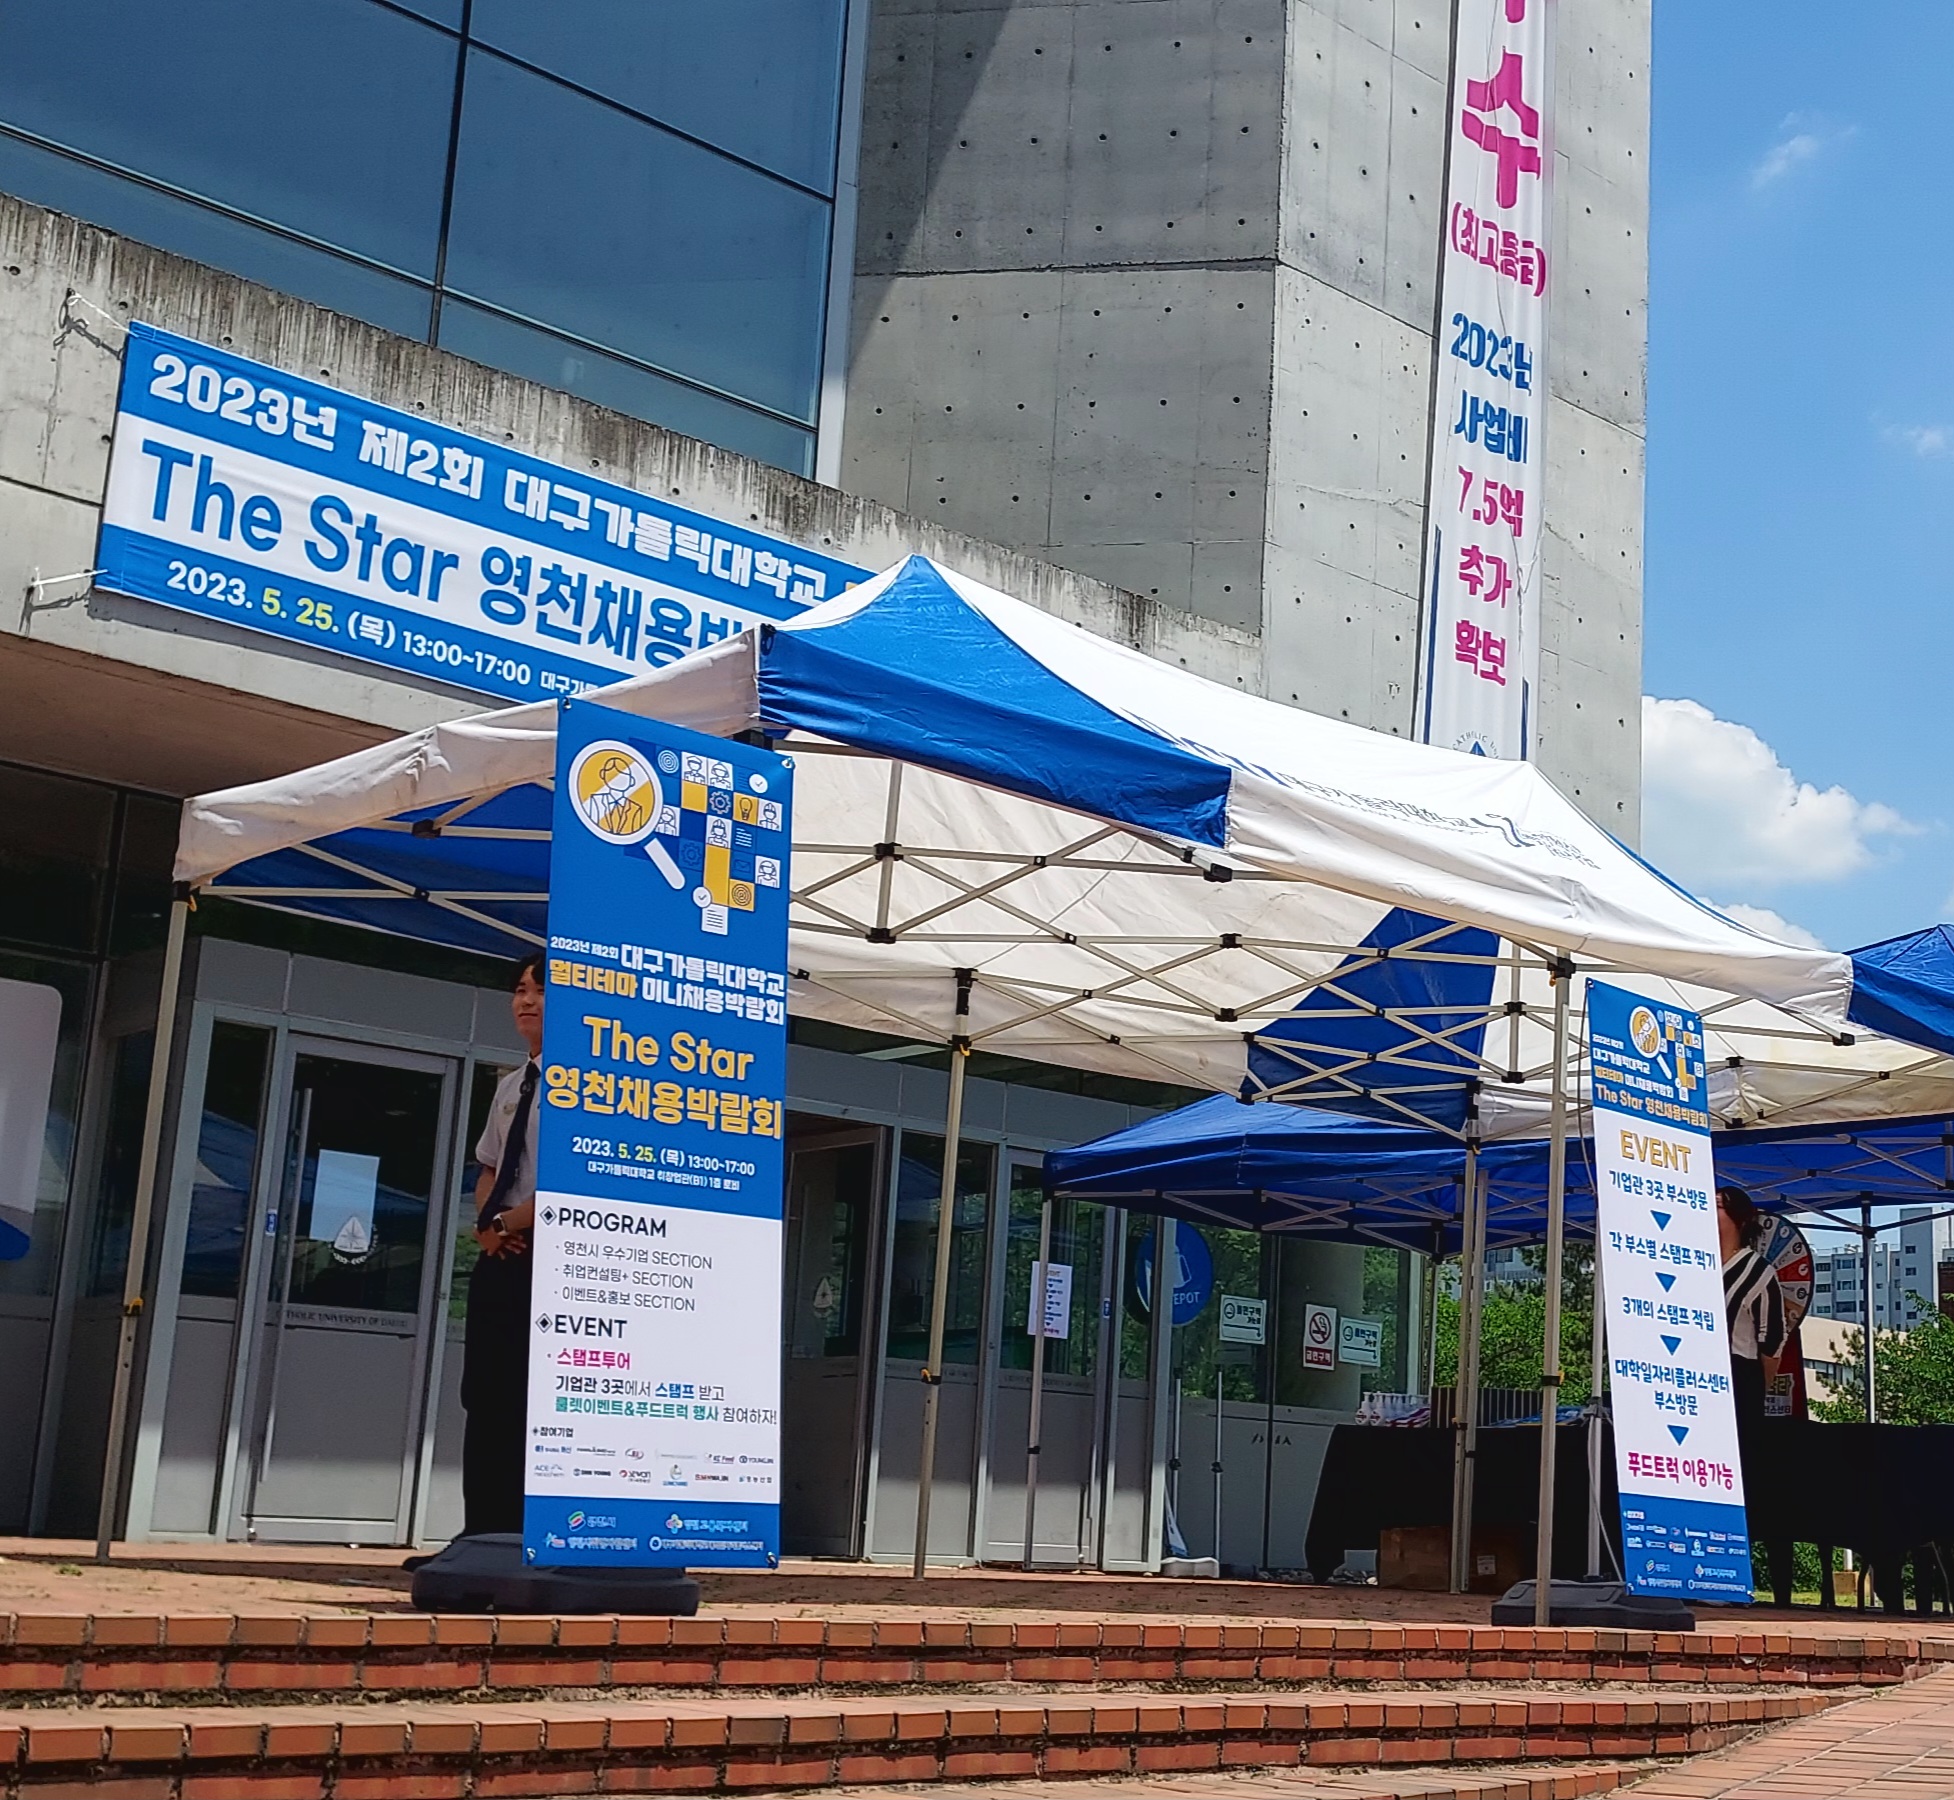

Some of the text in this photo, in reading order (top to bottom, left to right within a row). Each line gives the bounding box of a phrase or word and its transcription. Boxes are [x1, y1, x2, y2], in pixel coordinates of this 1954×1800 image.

[1451, 312, 1533, 397] 2023년
[1454, 389, 1529, 464] 사업비
[149, 353, 827, 607] 2023년 제2회 대구가톨릭대학교
[141, 438, 282, 553] The
[304, 494, 460, 603] Star
[1458, 464, 1525, 538] 7.5억
[1458, 544, 1512, 609] 추가
[167, 561, 253, 609] 2023.
[261, 587, 287, 619] 5.
[295, 599, 340, 633] 25.
[347, 611, 396, 649] (목)
[402, 630, 531, 685] 13:00~17:00
[1454, 619, 1507, 687] 확보
[550, 936, 785, 997] 2023년 제2회 대구가톨릭대학교
[549, 959, 784, 1025] 멀티테마 미니채용박람회
[583, 1015, 754, 1080] The Star
[545, 1064, 783, 1140] 영천채용박람회
[1595, 1083, 1618, 1103] The
[1620, 1089, 1643, 1110] Star
[572, 1136, 755, 1176] 2023. 5. 25. (목) 13:00~17:00
[1620, 1129, 1692, 1174] EVENT
[1609, 1170, 1708, 1211] 기업관 3곳 부스방문
[558, 1207, 667, 1238] PROGRAM
[563, 1240, 712, 1270] 영천시 우수기업 SECTION
[1609, 1231, 1716, 1270] 각 부스별 스탬프 찍기
[562, 1264, 693, 1290] 취업컨설팅+ SECTION
[562, 1286, 695, 1311] 이벤트&홍보 SECTION
[1173, 1291, 1200, 1305] EPOT
[1622, 1297, 1714, 1332] 3개의 스탬프 적립
[554, 1314, 627, 1339] EVENT
[557, 1348, 631, 1370] 스탬프투어
[1306, 1350, 1330, 1363] 금연구역
[1615, 1359, 1729, 1393] 대학일자리플러스센터
[556, 1375, 725, 1401] 기업관 3곳에서 스탬프 받고
[1655, 1390, 1698, 1416] 부스방문
[692, 1405, 719, 1422] 행사
[723, 1407, 777, 1425] 참여하자!
[1628, 1452, 1733, 1490] 푸드트럭 이용가능
